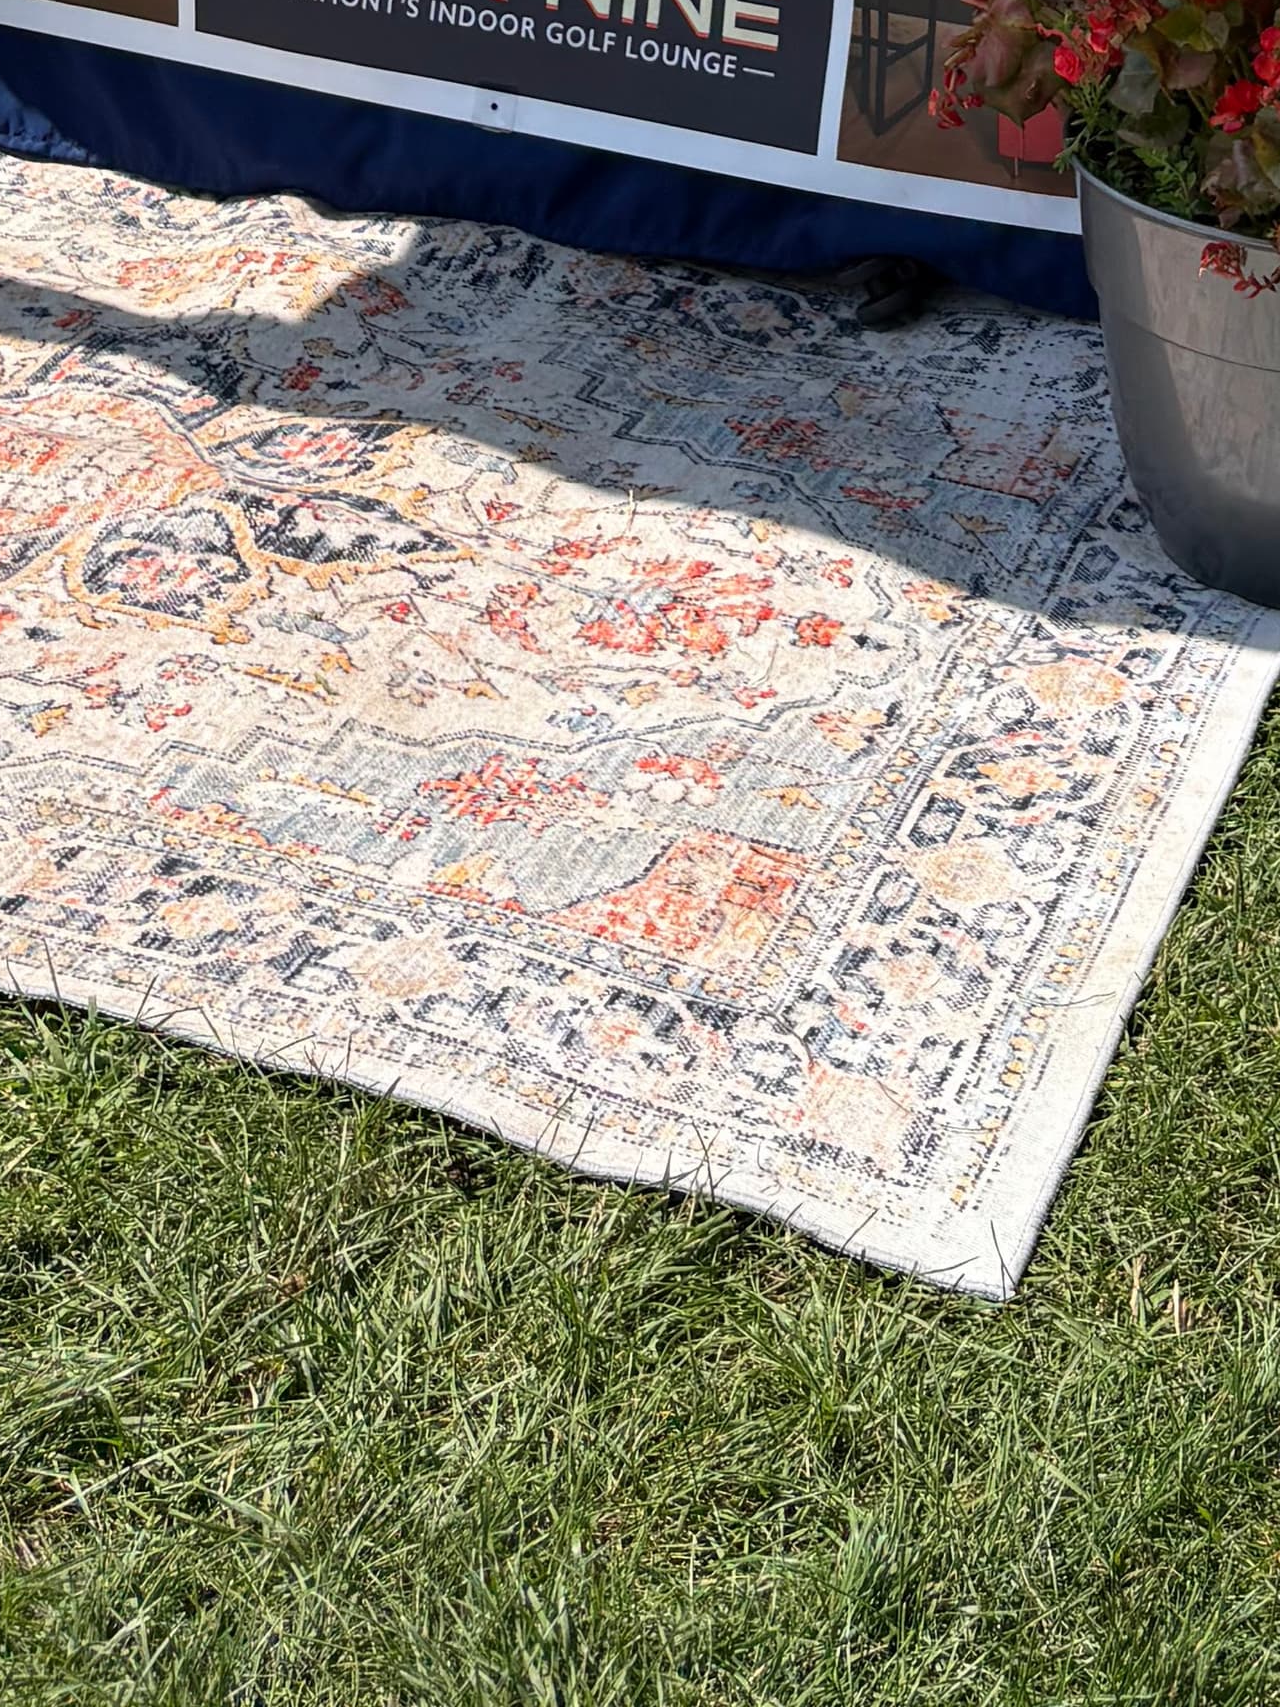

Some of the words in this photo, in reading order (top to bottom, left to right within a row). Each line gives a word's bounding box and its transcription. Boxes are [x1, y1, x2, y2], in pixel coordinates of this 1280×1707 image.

[429, 0, 536, 42] INDOOR
[545, 21, 616, 56] GOLF
[625, 34, 738, 79] LOUNGE
